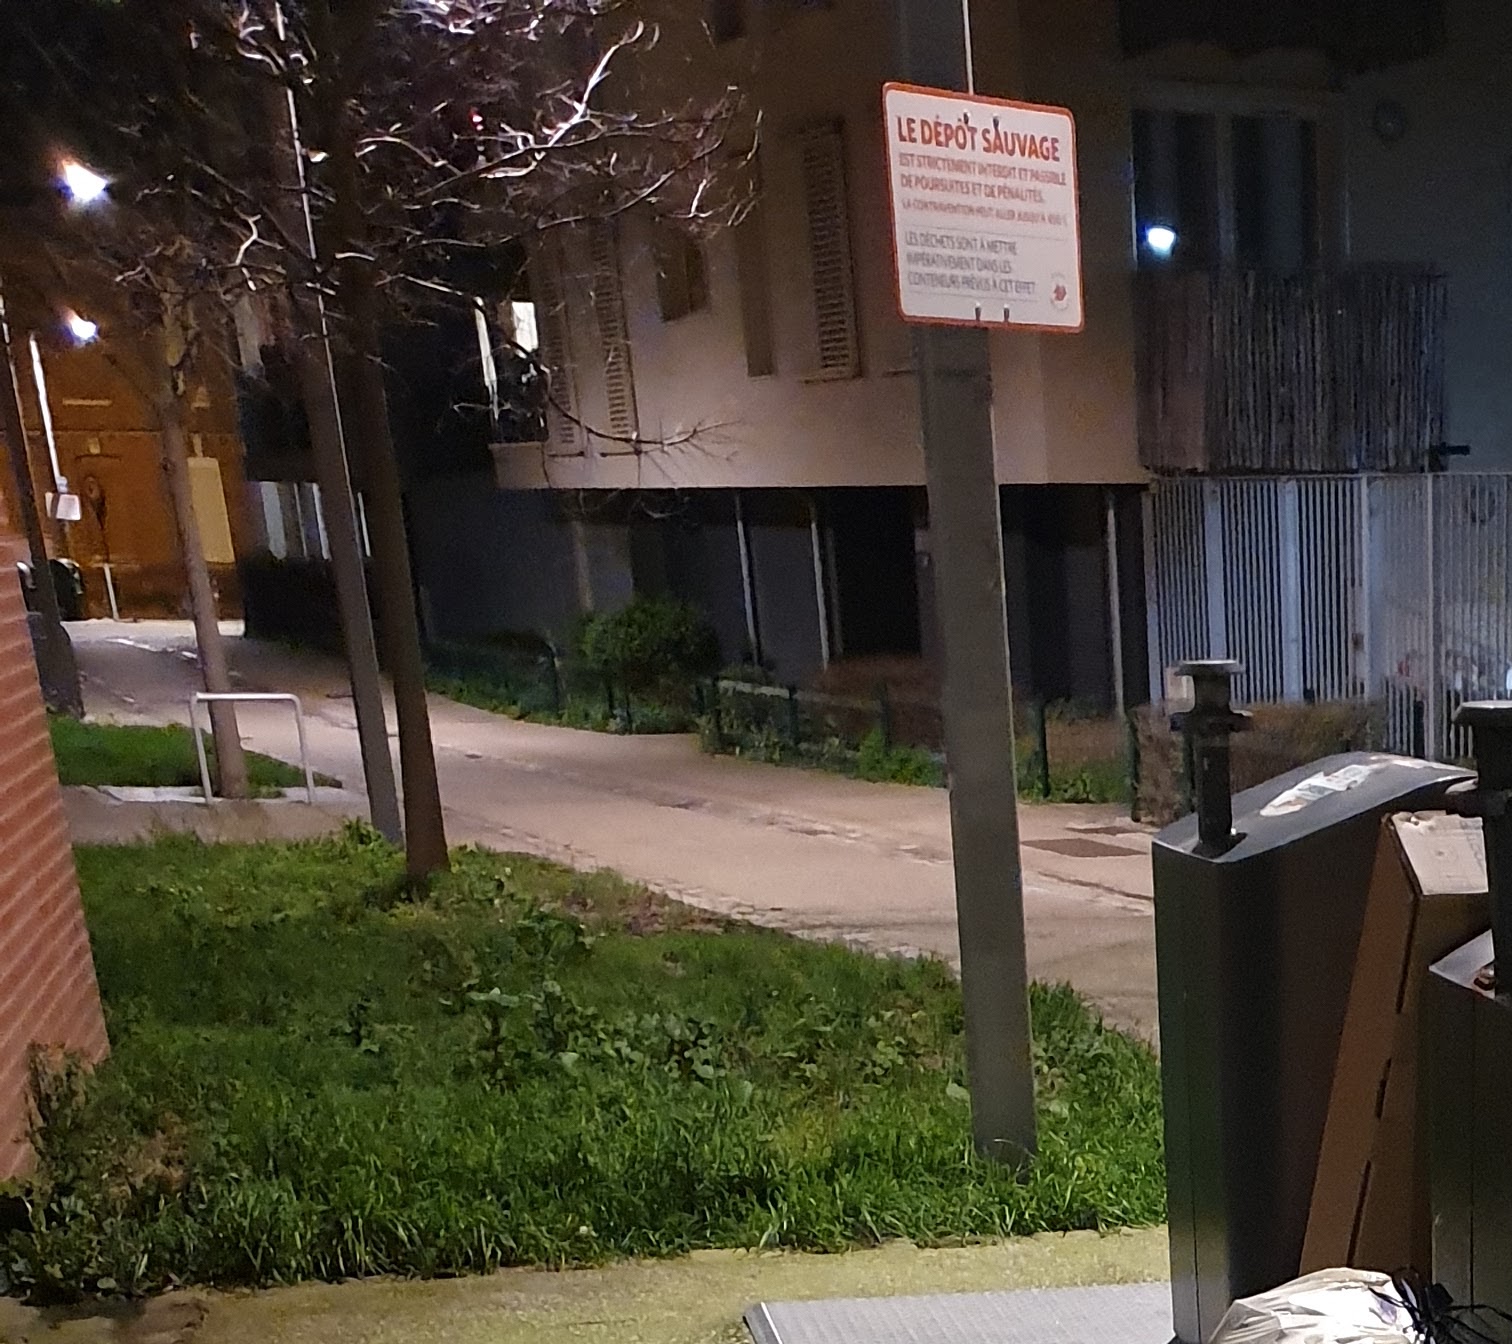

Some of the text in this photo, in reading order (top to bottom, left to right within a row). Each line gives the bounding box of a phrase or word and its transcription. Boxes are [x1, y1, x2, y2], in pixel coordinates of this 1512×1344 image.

[896, 114, 1060, 162] LE DÉPÔT SAUVAGE
[899, 152, 914, 168] EST
[917, 154, 976, 175] STRICTEMENT
[901, 173, 913, 188] DE
[915, 175, 970, 194] POURSUITES
[972, 182, 982, 196] ET
[984, 184, 996, 198] DE
